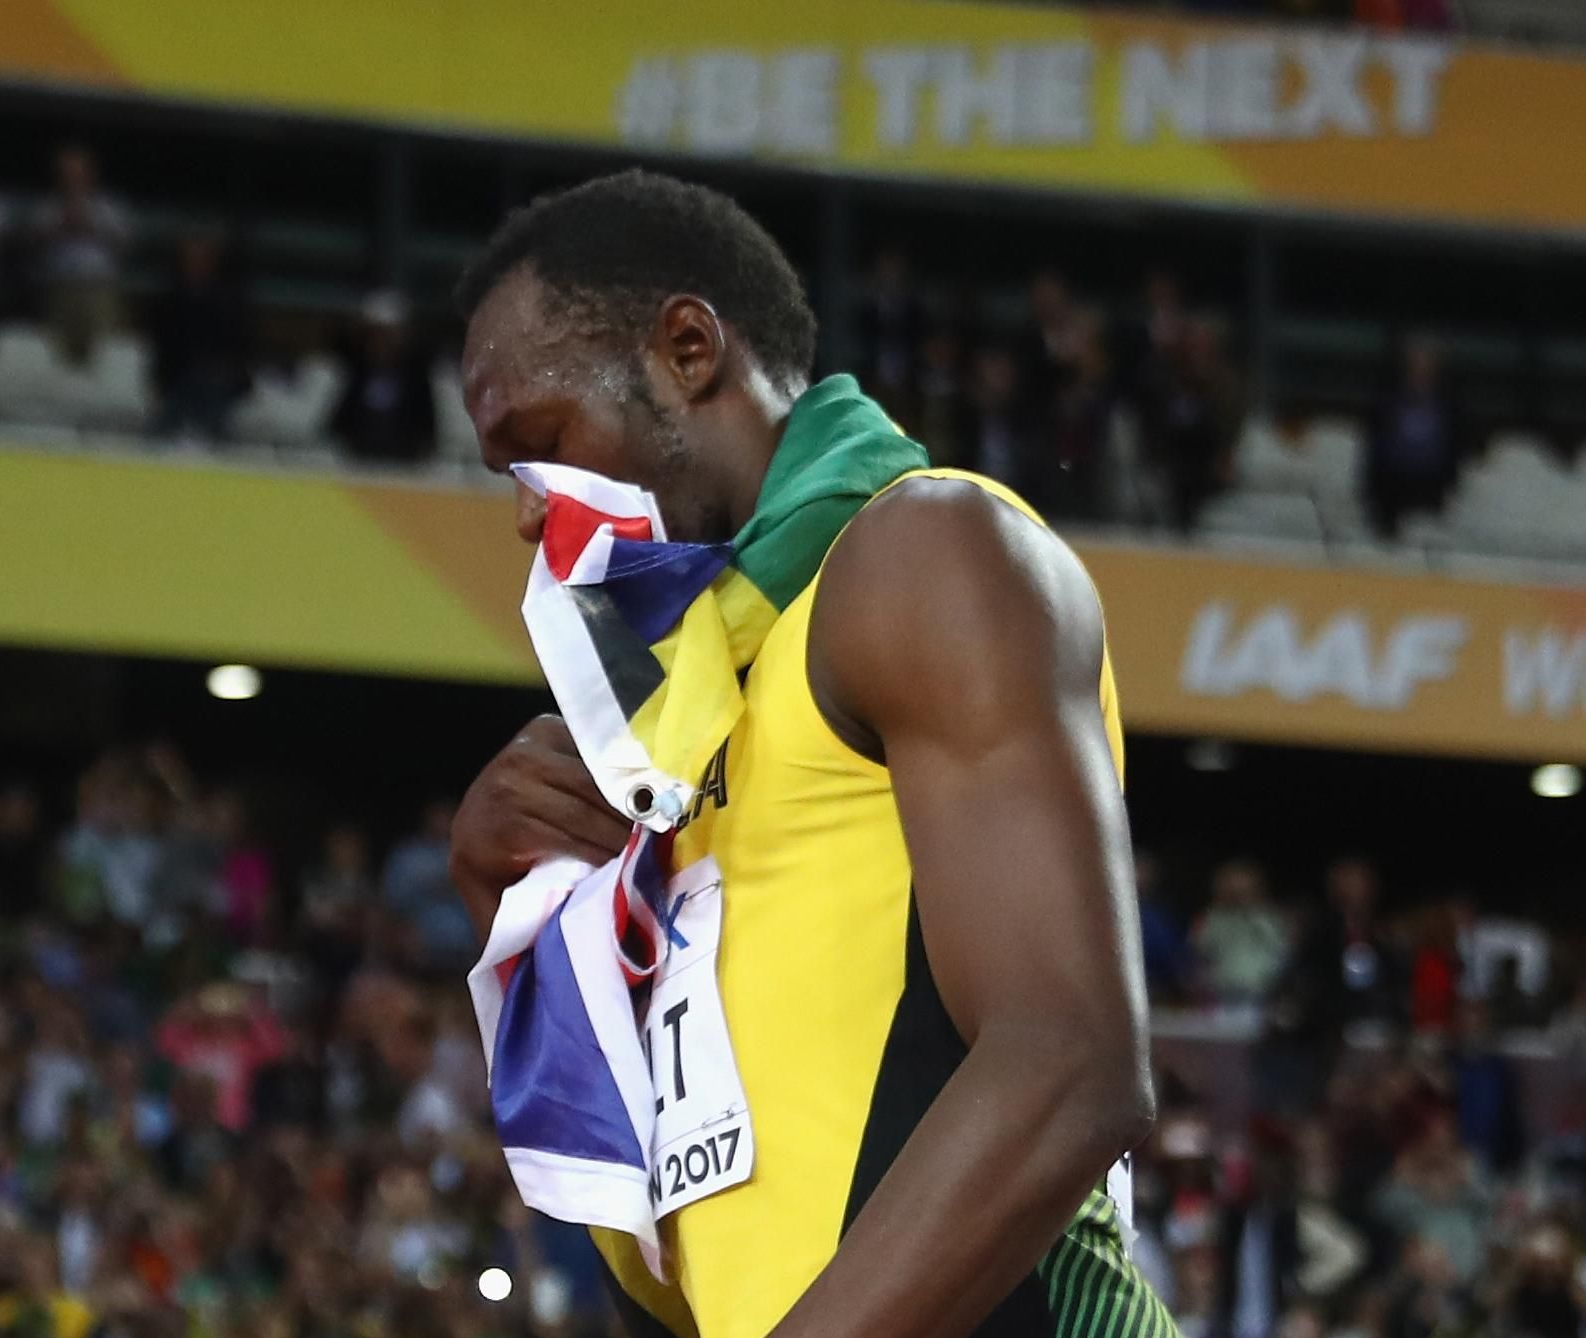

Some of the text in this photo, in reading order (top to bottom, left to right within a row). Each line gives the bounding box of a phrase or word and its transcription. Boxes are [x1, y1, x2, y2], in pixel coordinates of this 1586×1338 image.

[617, 36, 1451, 154] #BE THE NEXT
[1179, 600, 1468, 711] IAAF
[665, 1126, 742, 1197] 2017
